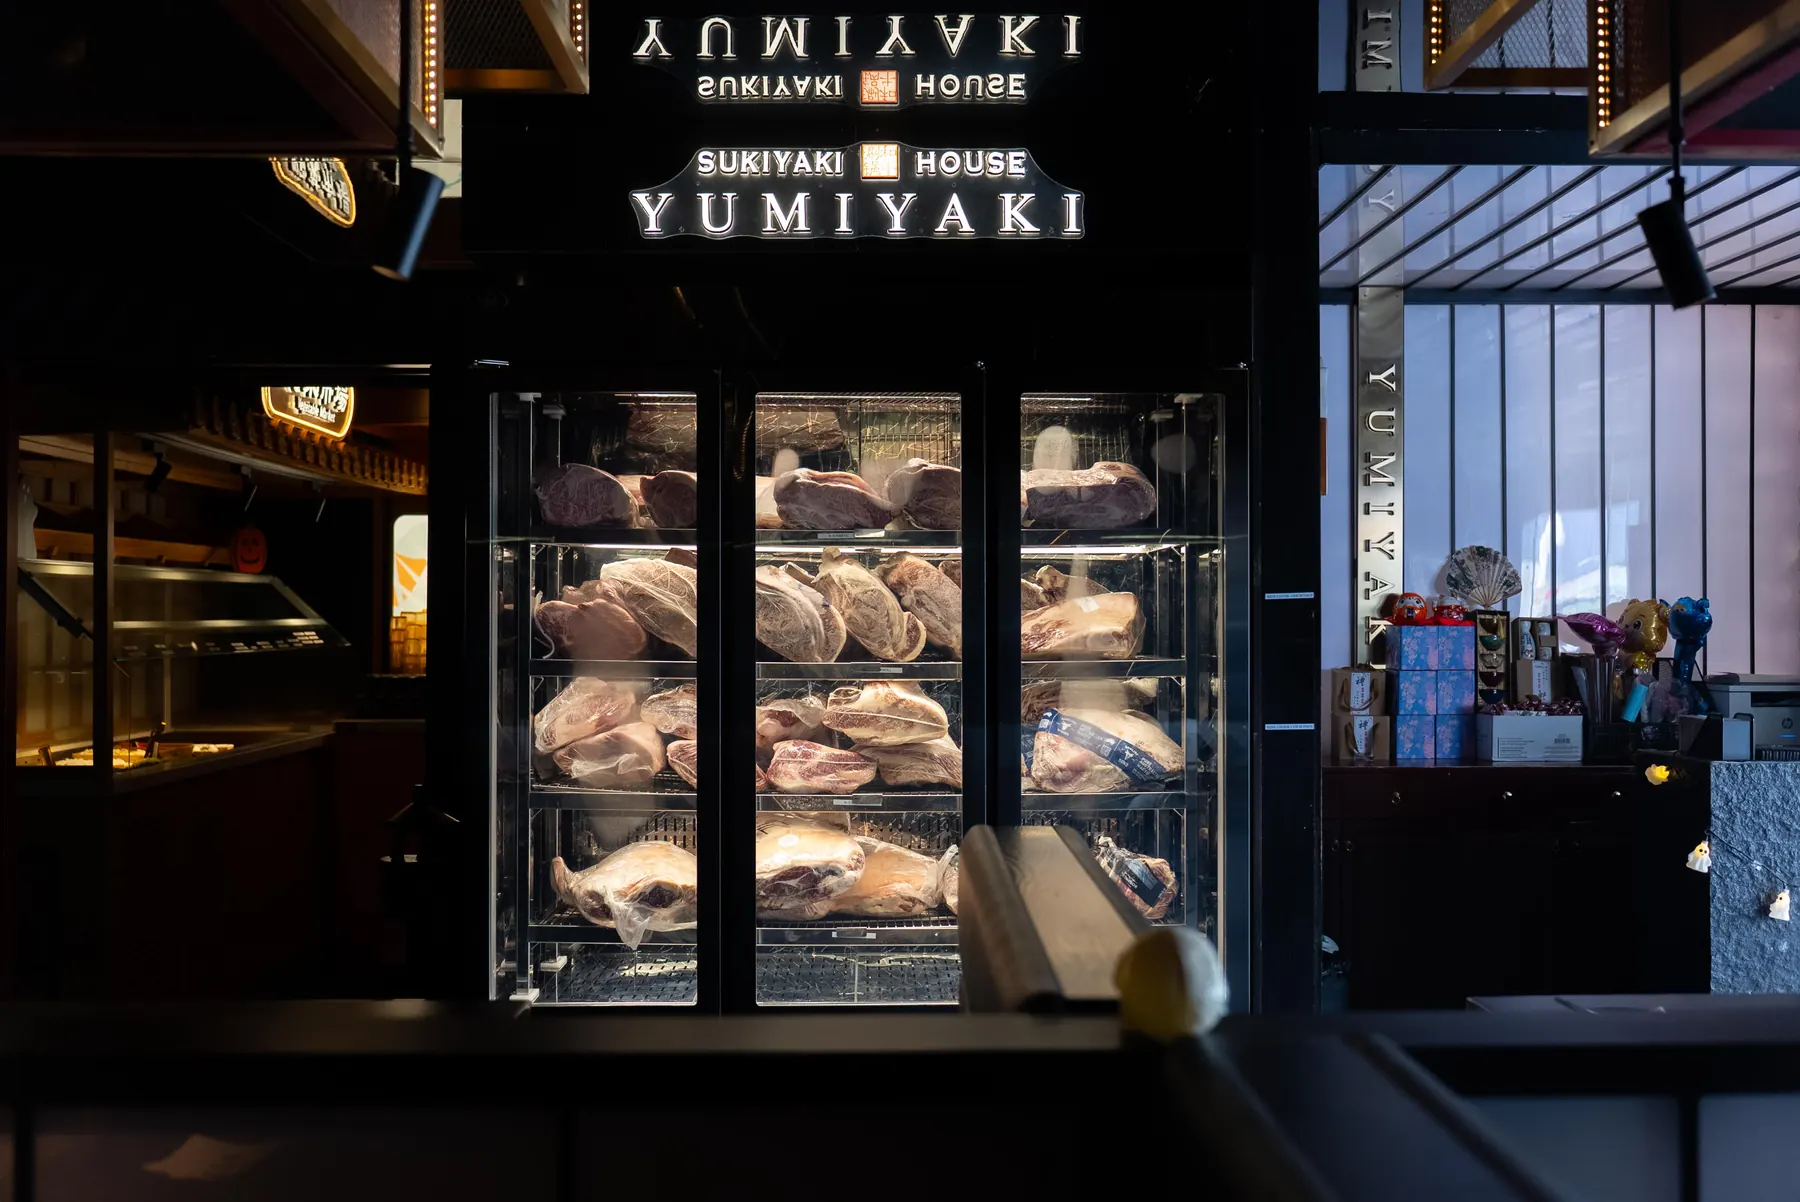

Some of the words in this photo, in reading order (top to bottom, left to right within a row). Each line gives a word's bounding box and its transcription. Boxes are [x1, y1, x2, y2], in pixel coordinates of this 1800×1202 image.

[697, 150, 843, 176] SUKIYAKI
[916, 150, 1026, 176] HOUSE
[632, 192, 1082, 234] YUMIYAKI
